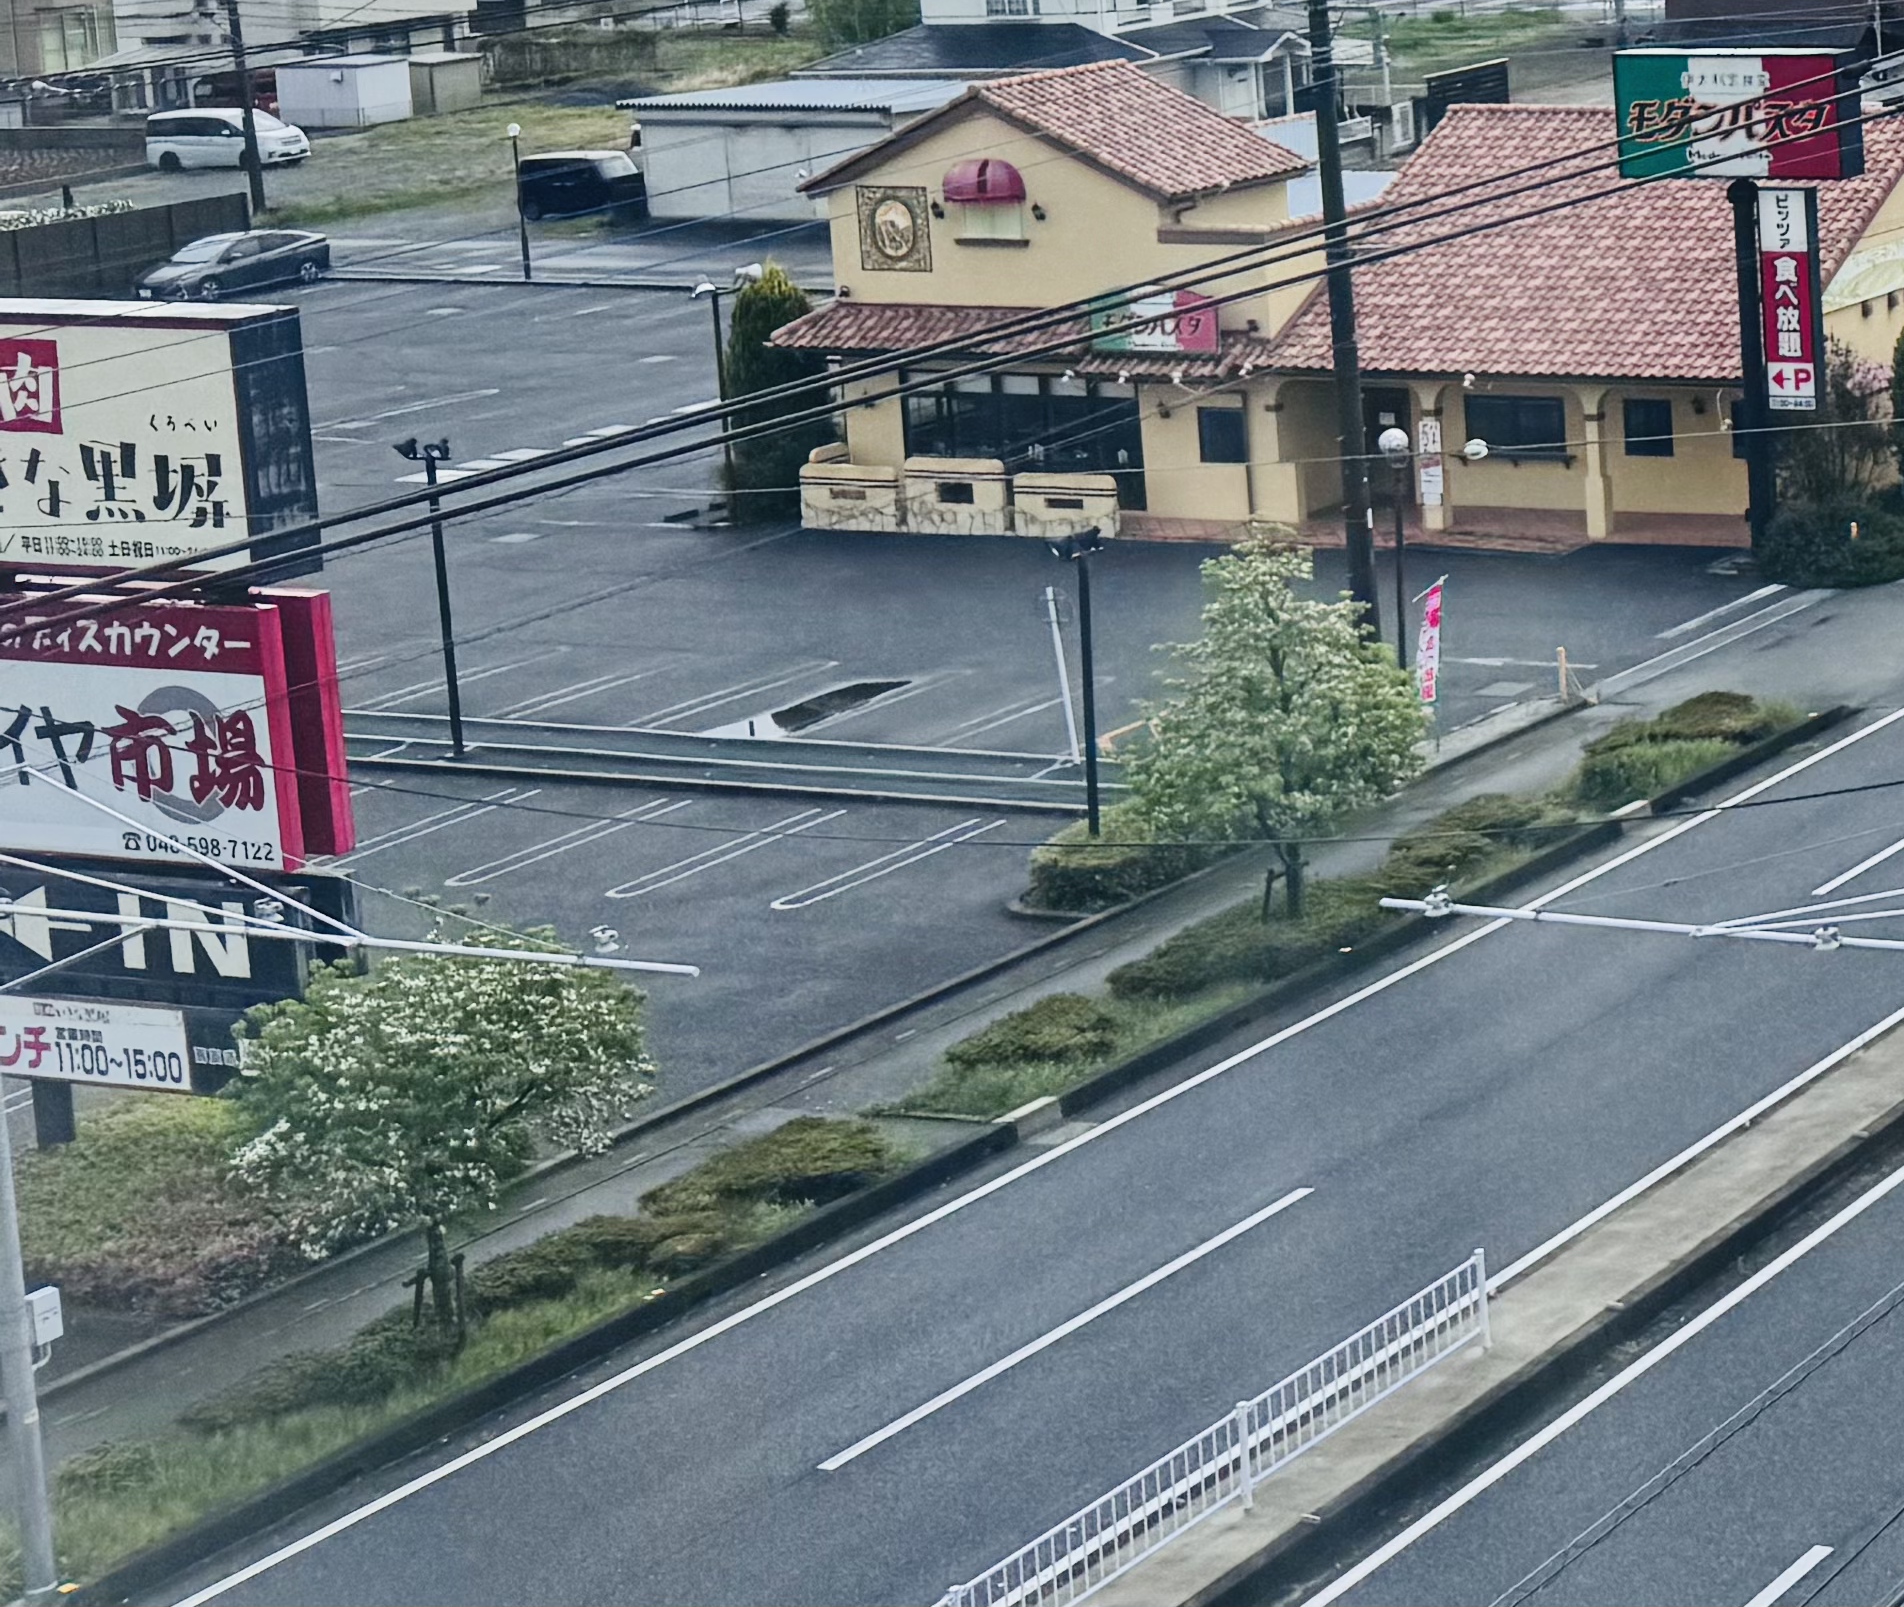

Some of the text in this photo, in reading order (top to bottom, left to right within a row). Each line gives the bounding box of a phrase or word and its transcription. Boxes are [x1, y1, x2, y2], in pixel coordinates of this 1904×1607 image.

[1773, 256, 1803, 358] 食べ放題
[0, 352, 54, 424] 肉
[1793, 368, 1812, 392] P
[149, 414, 218, 432] くろべい
[117, 893, 251, 978] IN
[55, 1041, 182, 1083] 11:00~15:00
